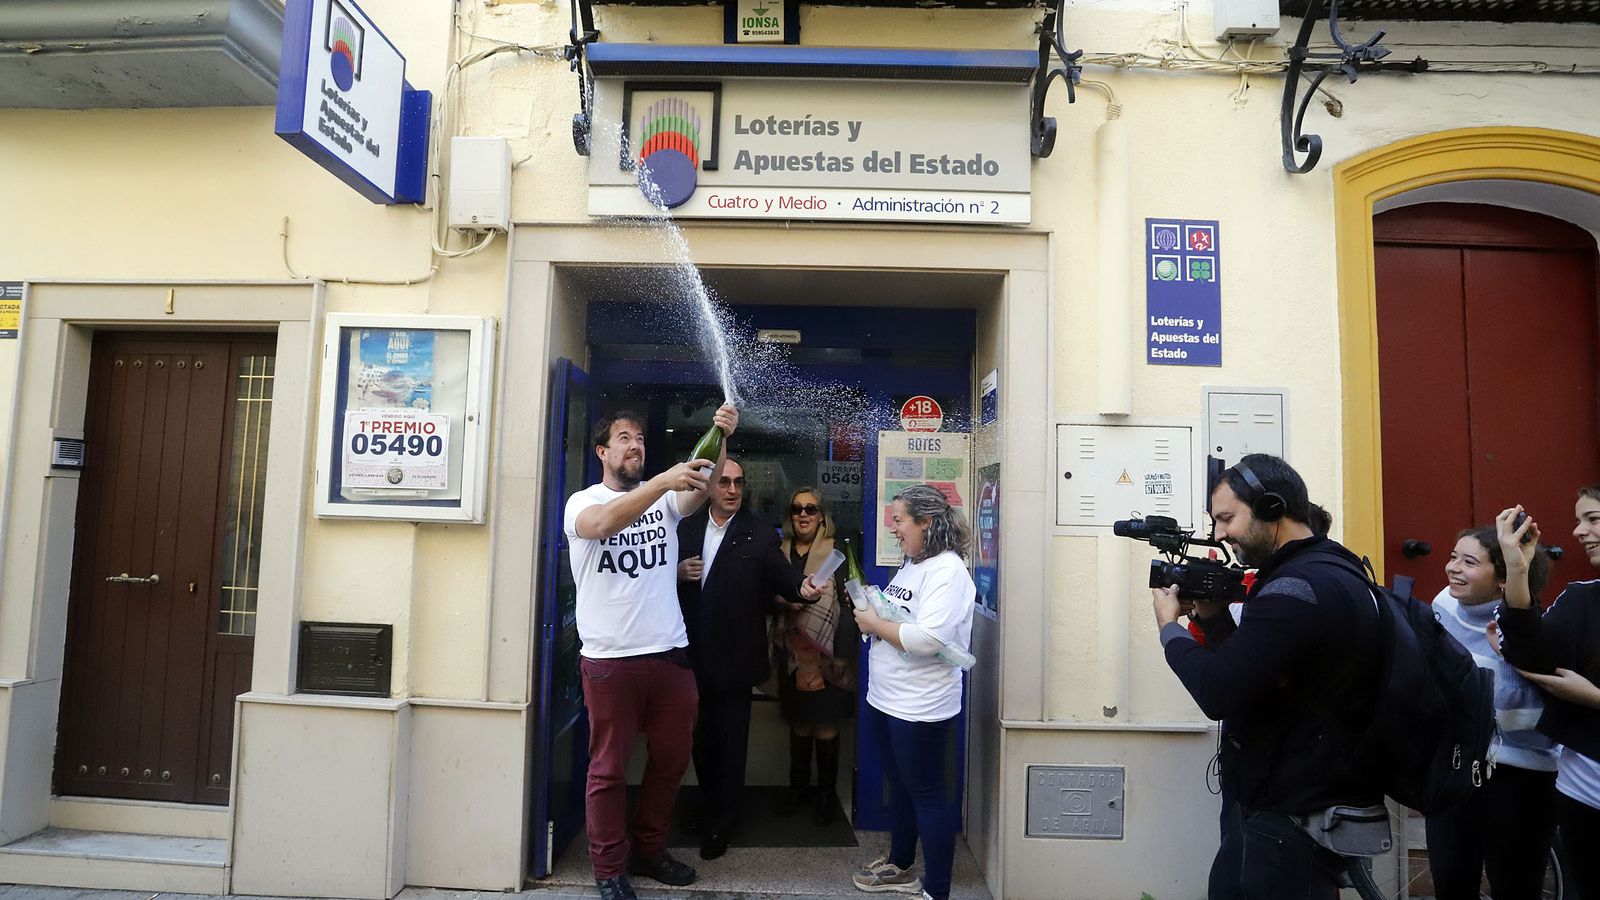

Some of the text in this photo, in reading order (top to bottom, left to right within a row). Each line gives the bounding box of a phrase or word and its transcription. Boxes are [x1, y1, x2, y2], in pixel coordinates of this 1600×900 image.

[743, 17, 779, 29] IONSA
[320, 78, 369, 132] Loterías y
[318, 117, 353, 154] Estado
[319, 99, 380, 158] Apuestas del
[734, 114, 863, 142] Loterías y
[734, 149, 1000, 177] Apuestas del Estado
[708, 194, 759, 209] Cuatro
[764, 198, 775, 213] y
[778, 195, 828, 211] Medio
[852, 196, 965, 214] Administración
[990, 200, 999, 214] 2
[1151, 315, 1204, 330] Loterías y
[1151, 332, 1219, 344] Apuestas del
[1151, 347, 1187, 360] Estado
[909, 400, 932, 414] +18
[372, 421, 436, 435] PREMIO
[351, 433, 443, 456] 05490
[908, 438, 941, 451] BOTES
[599, 526, 666, 546] VENDIDO
[597, 540, 668, 579] AQUÍ
[1038, 772, 1115, 788] CONTADOR
[1042, 817, 1110, 832] DE AGUA
